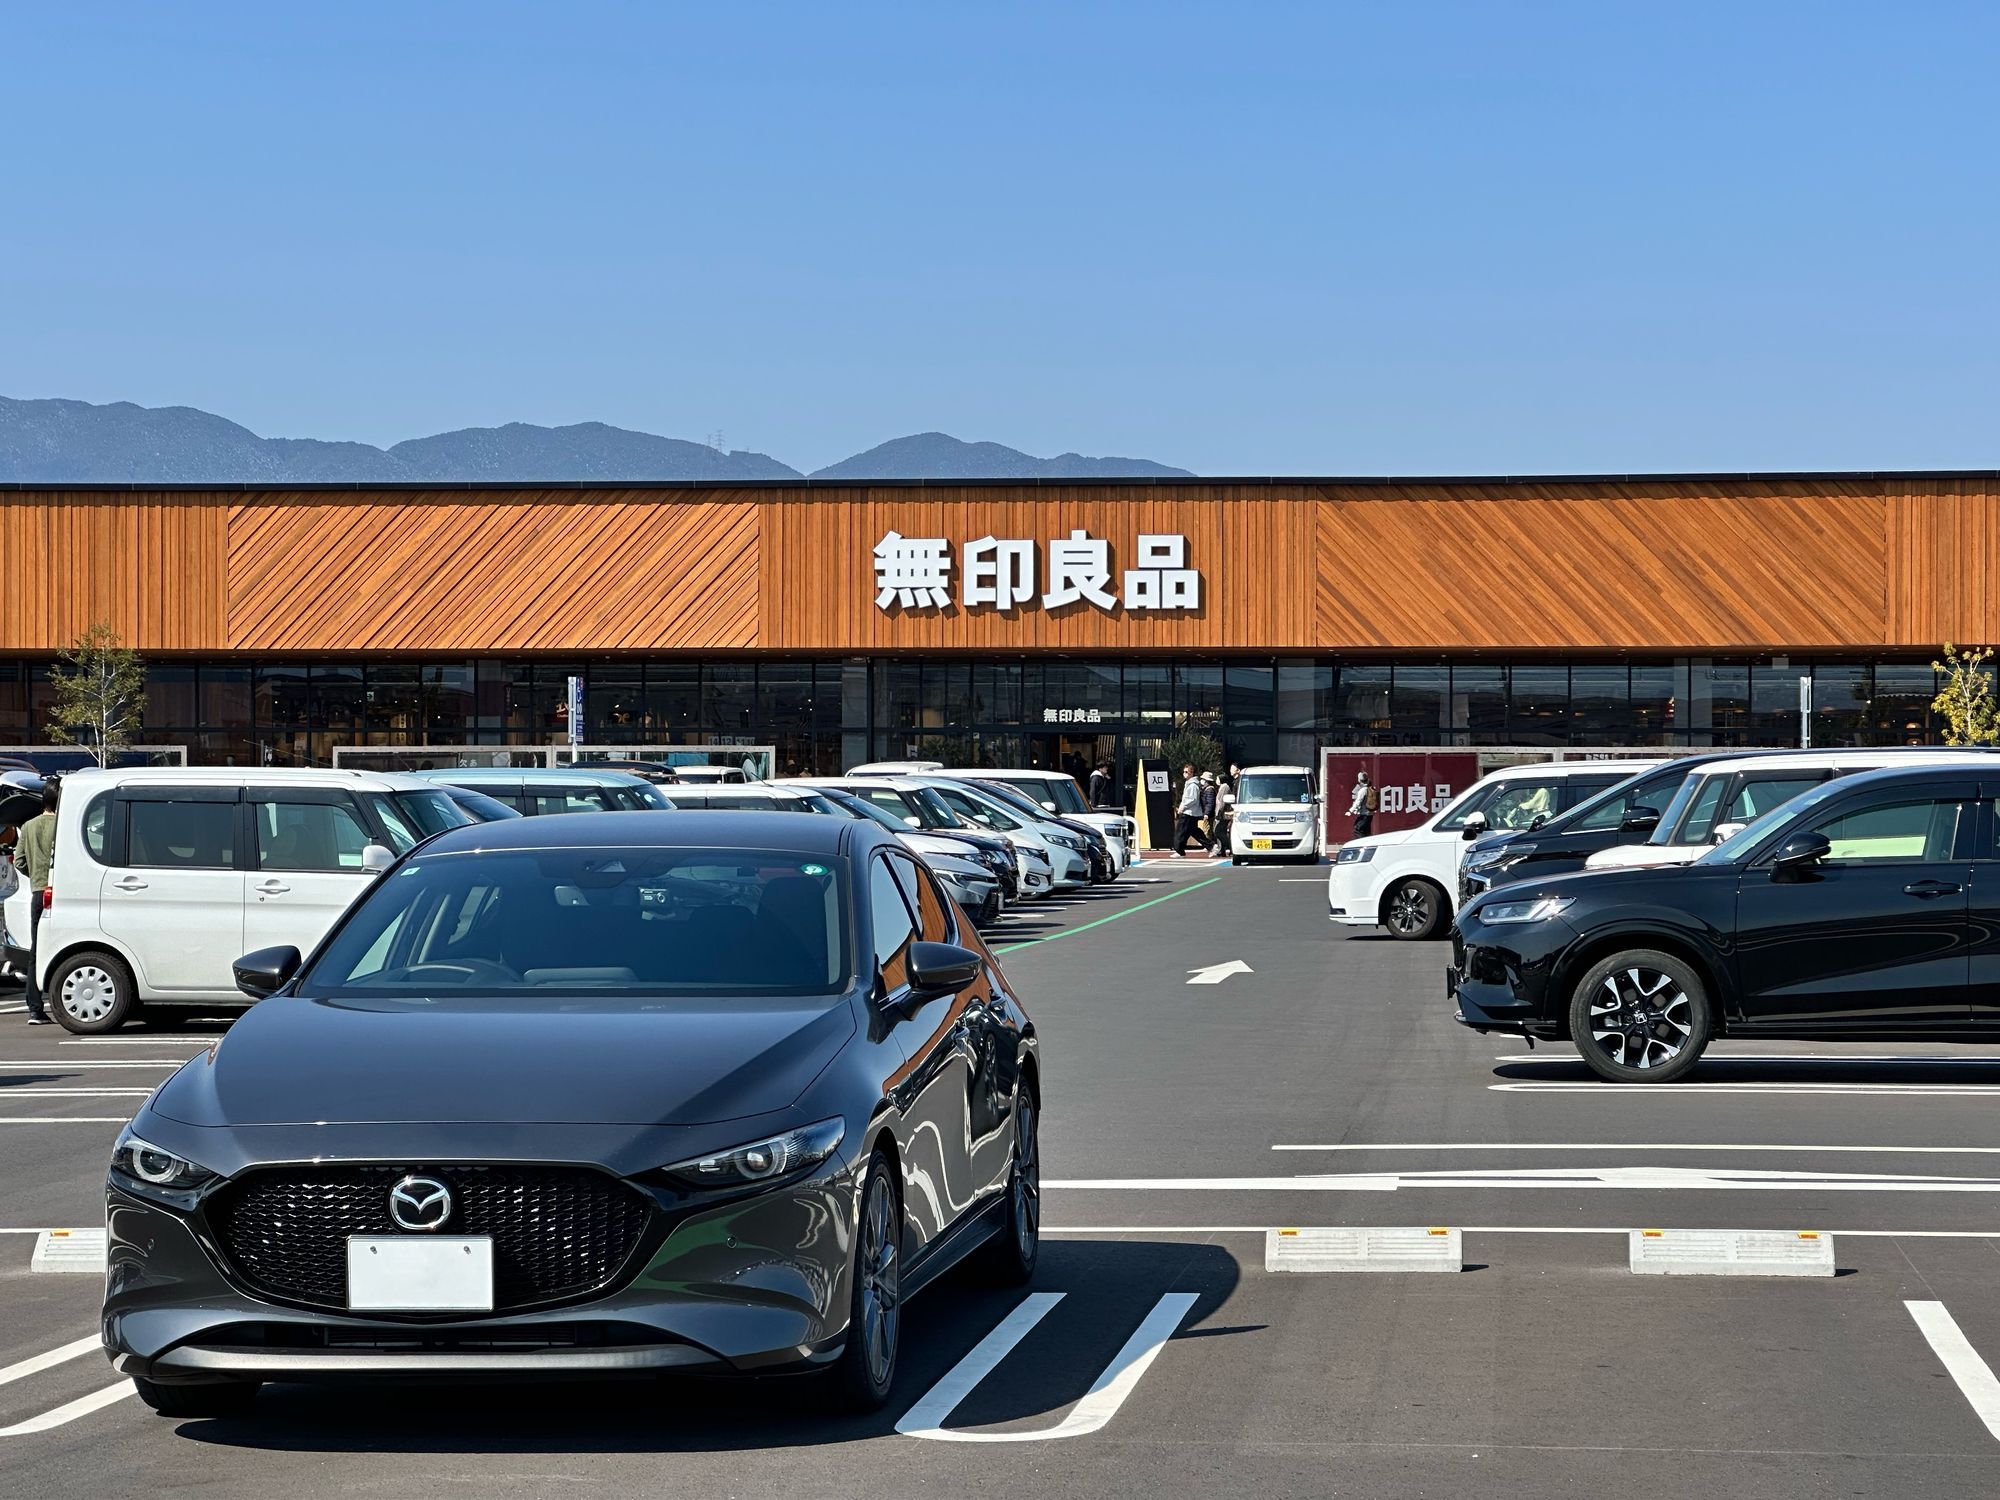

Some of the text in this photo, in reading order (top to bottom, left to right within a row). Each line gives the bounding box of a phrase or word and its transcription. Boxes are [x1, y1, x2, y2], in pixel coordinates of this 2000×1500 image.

[873, 529, 1199, 611] 無印良品
[1043, 707, 1101, 723] 無印良品
[1151, 776, 1164, 784] 入口
[1352, 783, 1454, 814] 印良品
